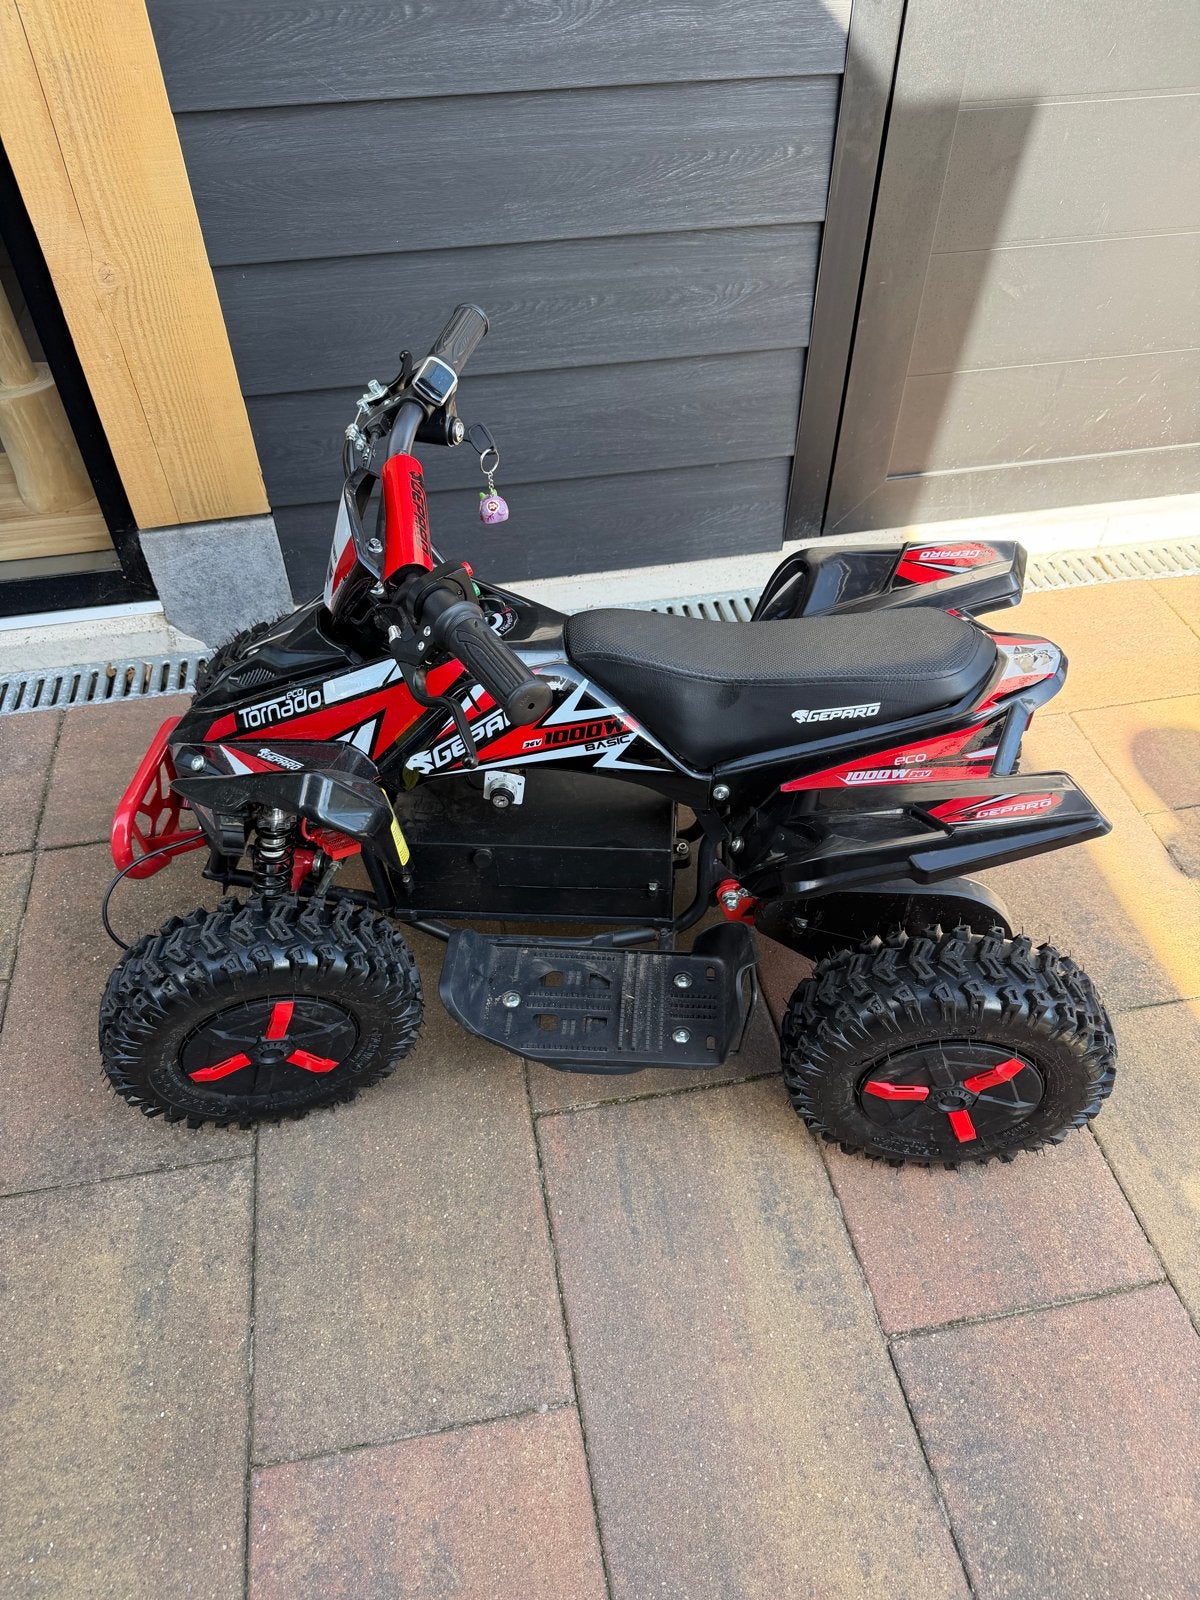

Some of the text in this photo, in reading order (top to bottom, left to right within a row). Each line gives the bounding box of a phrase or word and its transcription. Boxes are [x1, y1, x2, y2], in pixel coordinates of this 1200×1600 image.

[286, 687, 304, 699] eco
[239, 690, 322, 729] Tornado
[806, 702, 881, 723] GEPARD
[545, 718, 625, 745] 1000W
[585, 734, 631, 752] BASIC
[894, 753, 927, 766] eco
[845, 768, 911, 781] 1000W
